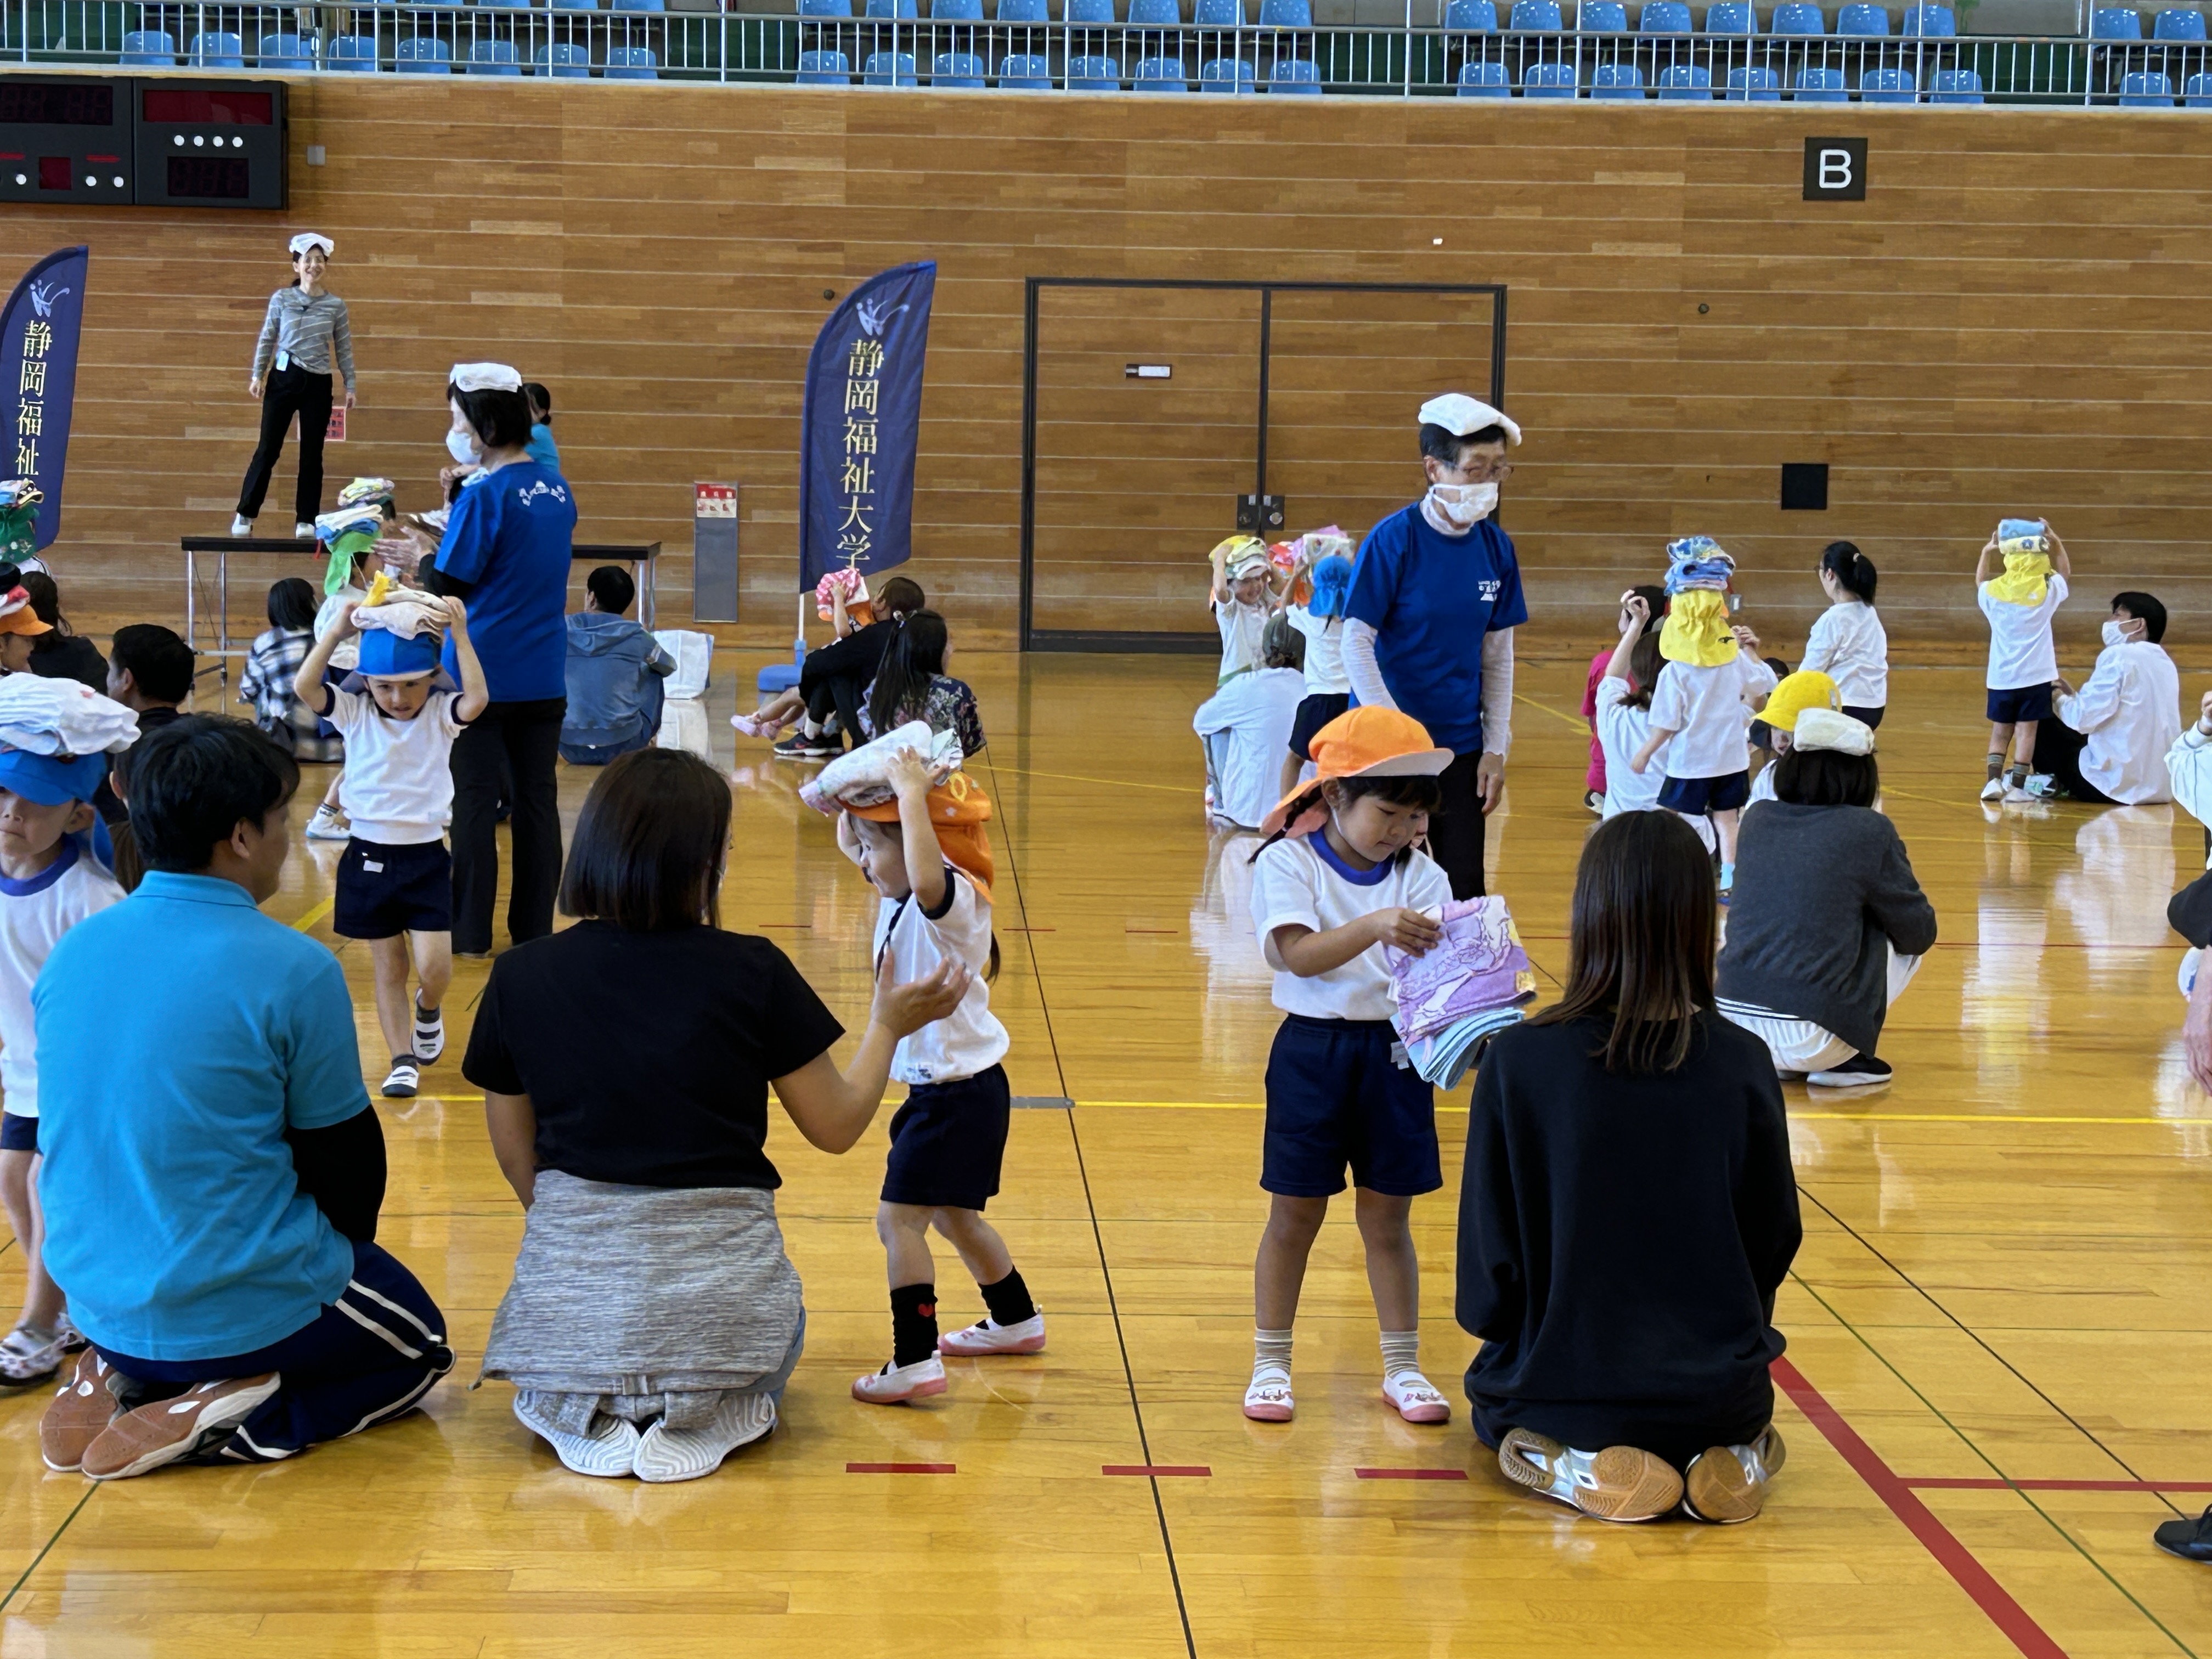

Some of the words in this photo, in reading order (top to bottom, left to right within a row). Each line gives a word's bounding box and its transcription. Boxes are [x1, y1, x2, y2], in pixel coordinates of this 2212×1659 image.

[1819, 149, 1852, 188] B
[836, 339, 884, 569] 静岡福祉大学
